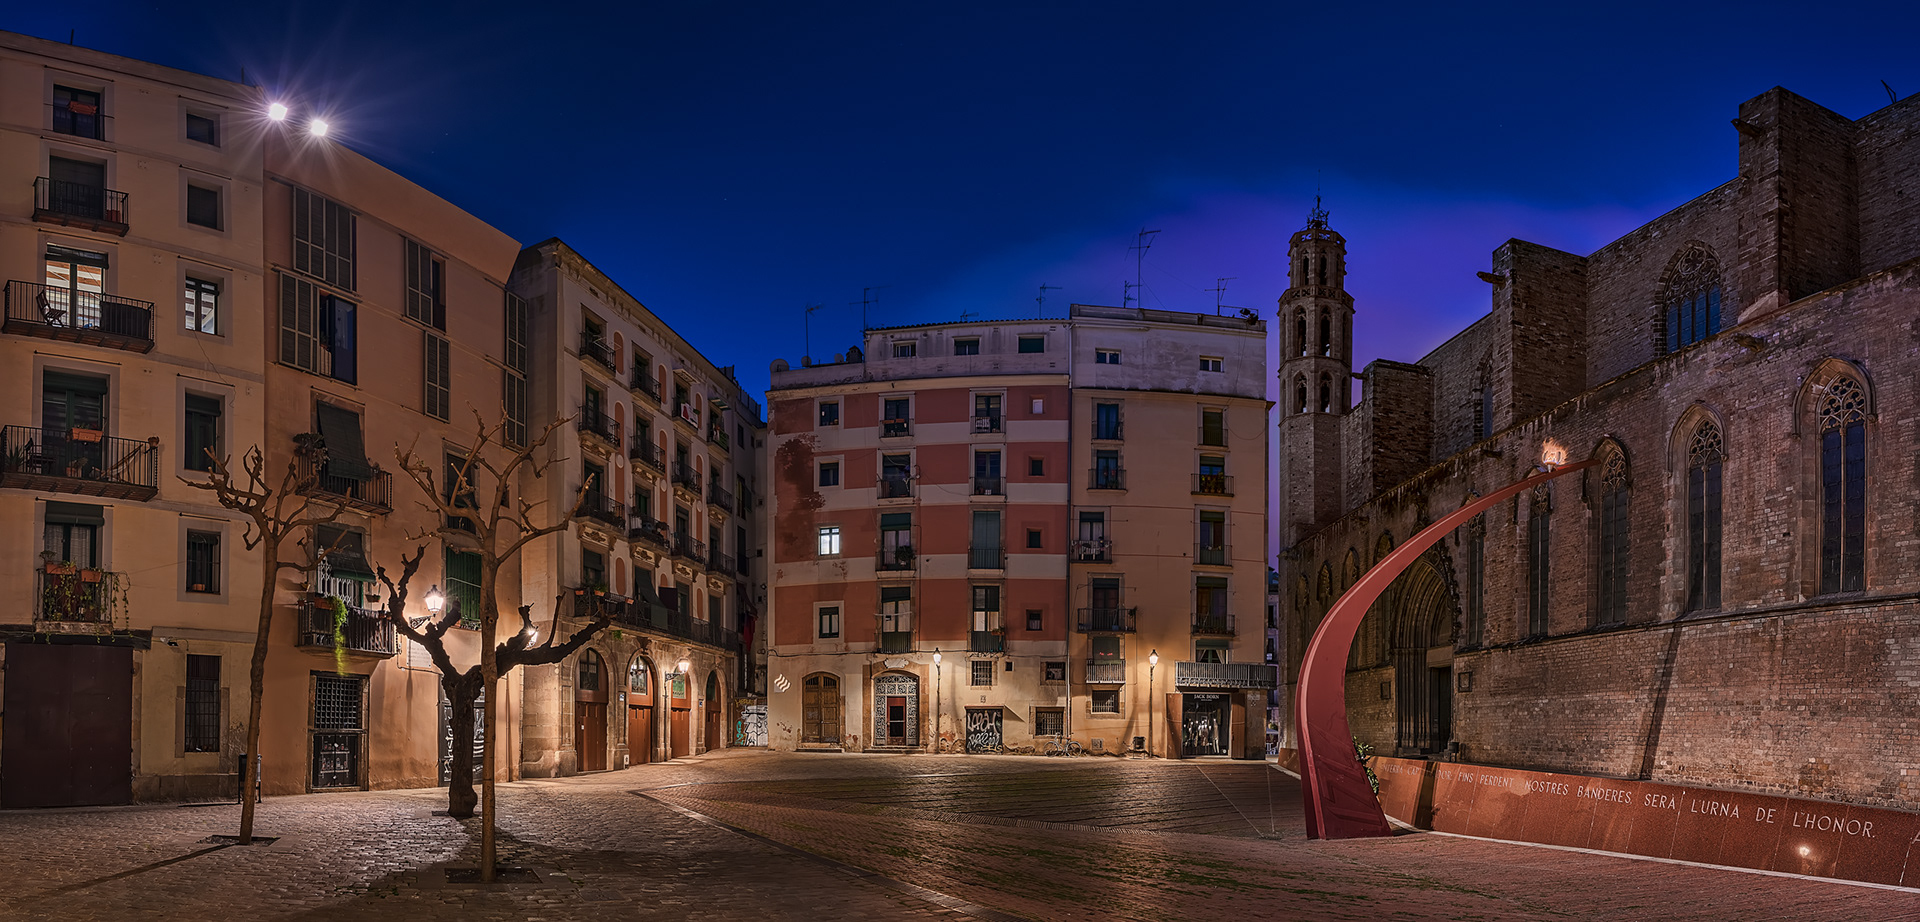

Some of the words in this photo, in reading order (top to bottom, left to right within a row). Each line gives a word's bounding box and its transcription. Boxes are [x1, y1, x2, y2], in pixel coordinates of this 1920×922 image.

[1457, 771, 1474, 783] FINS
[1479, 774, 1515, 788] PERDENT
[1524, 780, 1569, 796] NOSTRES
[1644, 792, 1676, 810] SERÀ
[1690, 798, 1740, 819] L'URNA
[1755, 807, 1777, 824] DE
